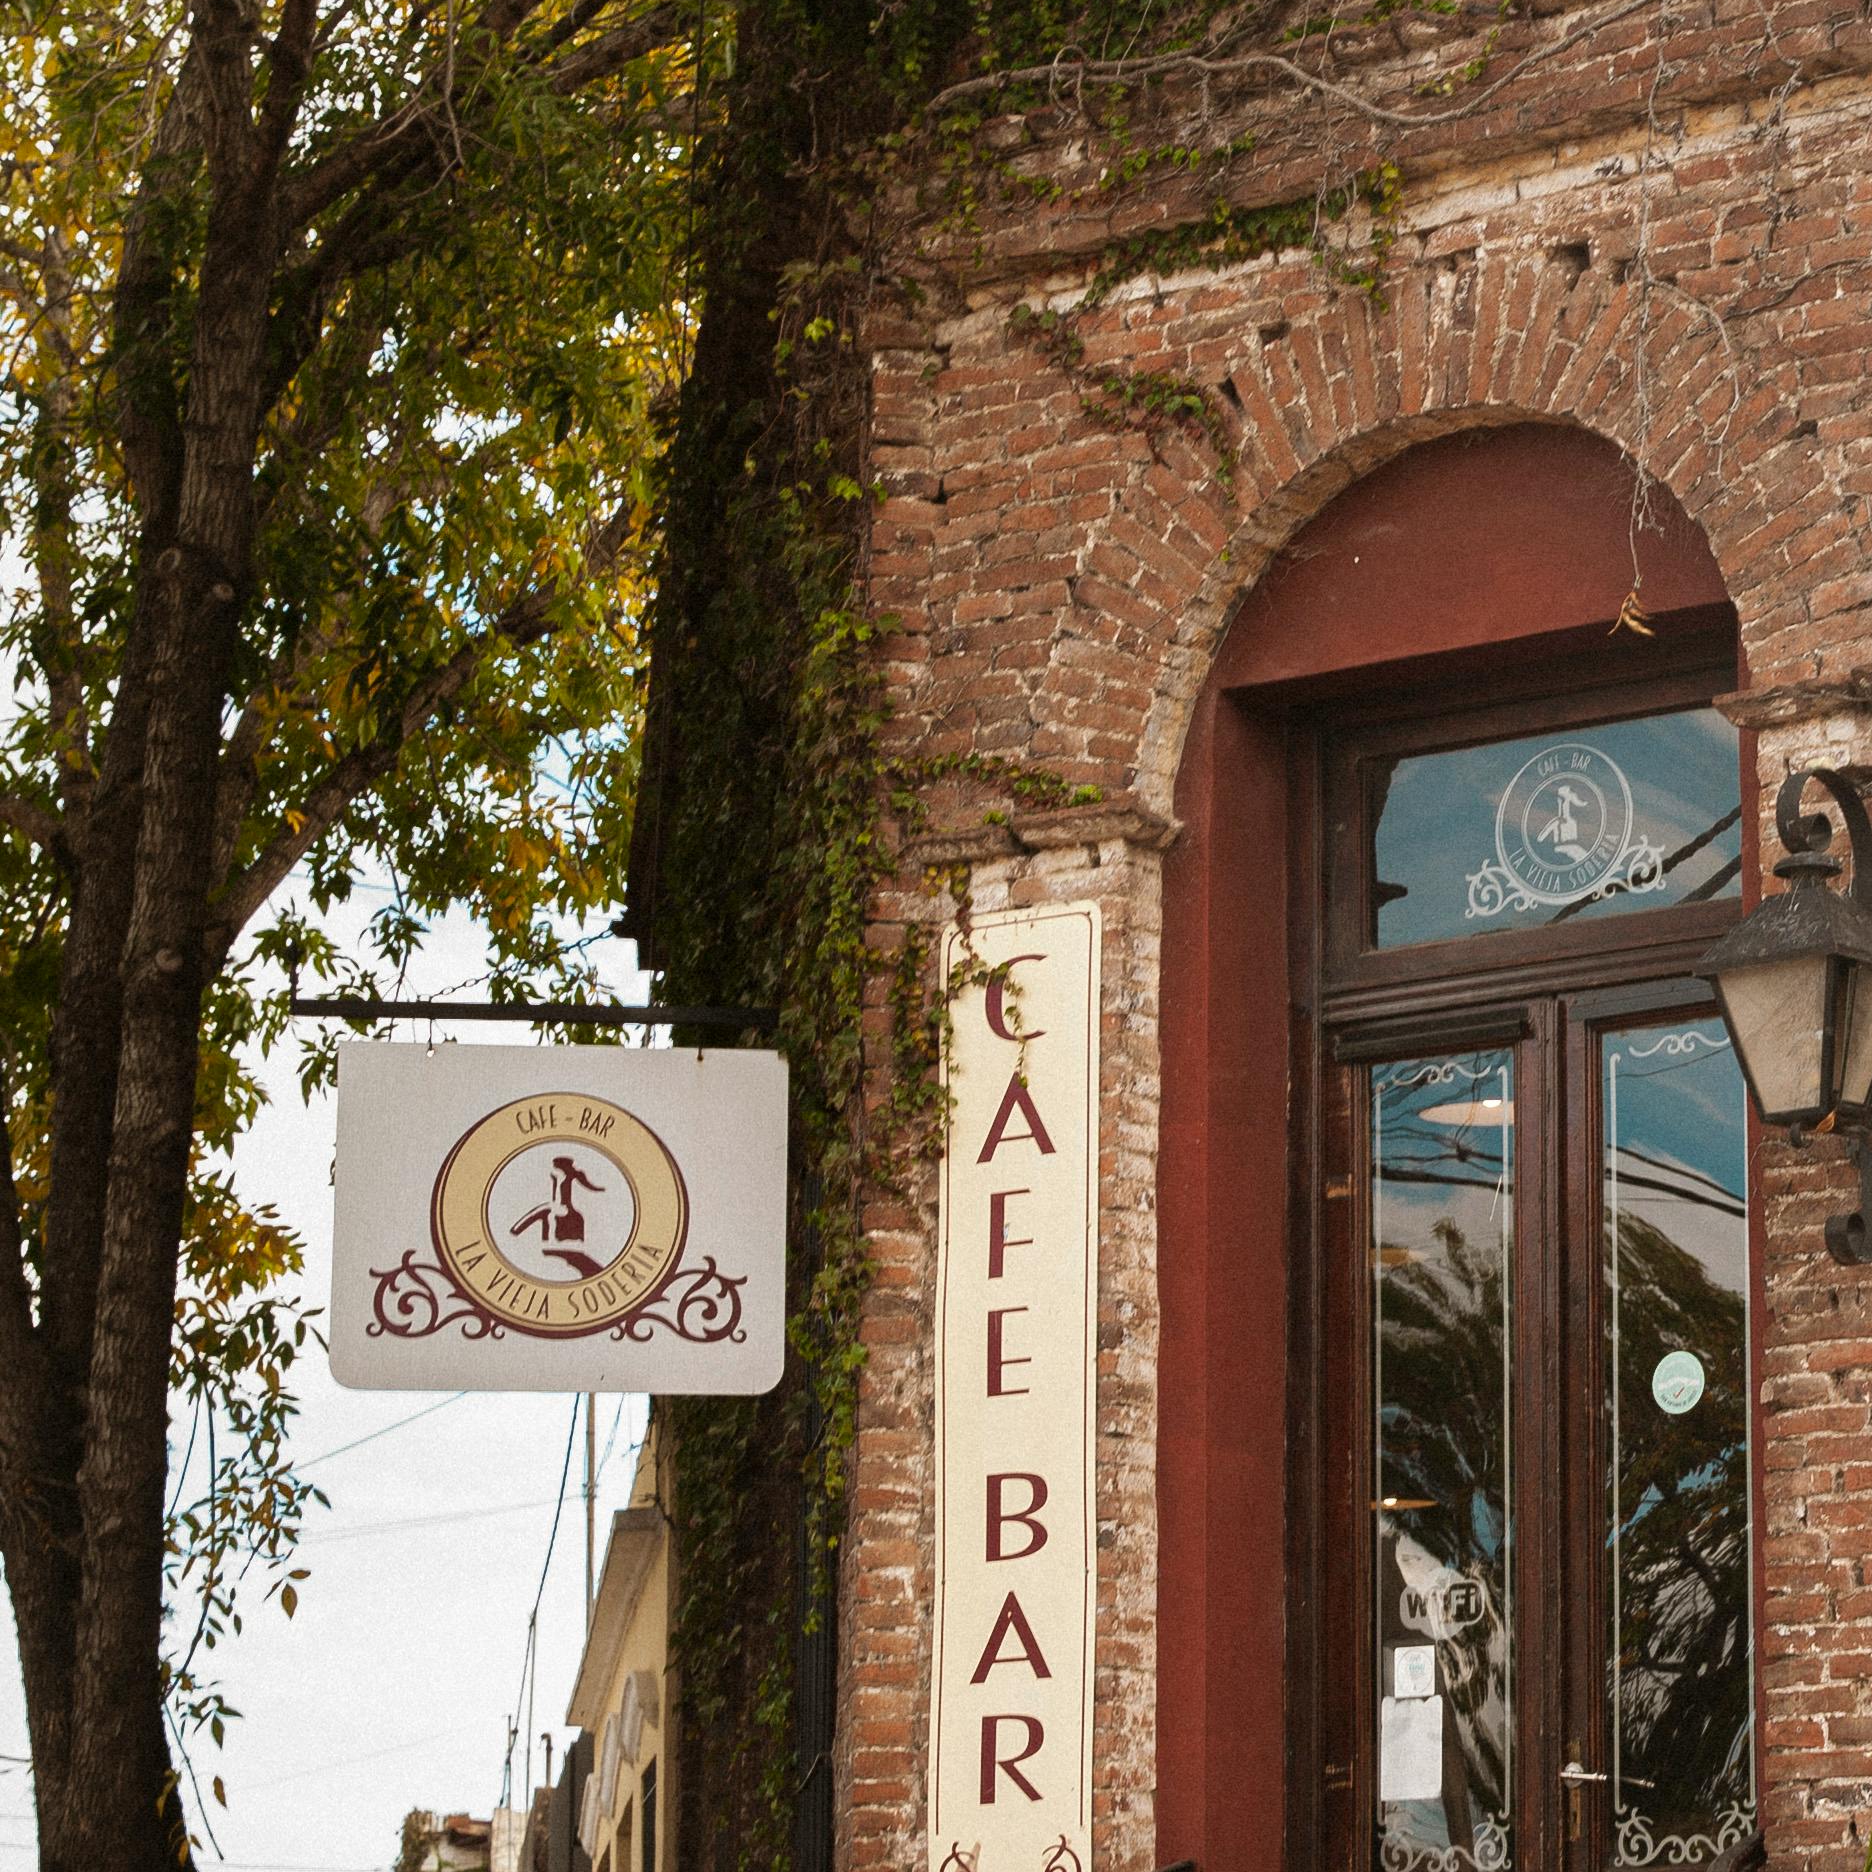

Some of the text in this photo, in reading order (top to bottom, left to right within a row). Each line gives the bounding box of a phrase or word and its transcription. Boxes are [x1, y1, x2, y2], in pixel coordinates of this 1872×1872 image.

[1570, 751, 1592, 771] BAR
[1509, 846, 1526, 870] LA
[1526, 865, 1560, 892] VIEJA
[515, 1103, 559, 1135] CAFE
[578, 1106, 616, 1139] BAR
[455, 1239, 664, 1321] LA VIEJA SODERIA
[969, 953, 1057, 1805] CAFE BAR
